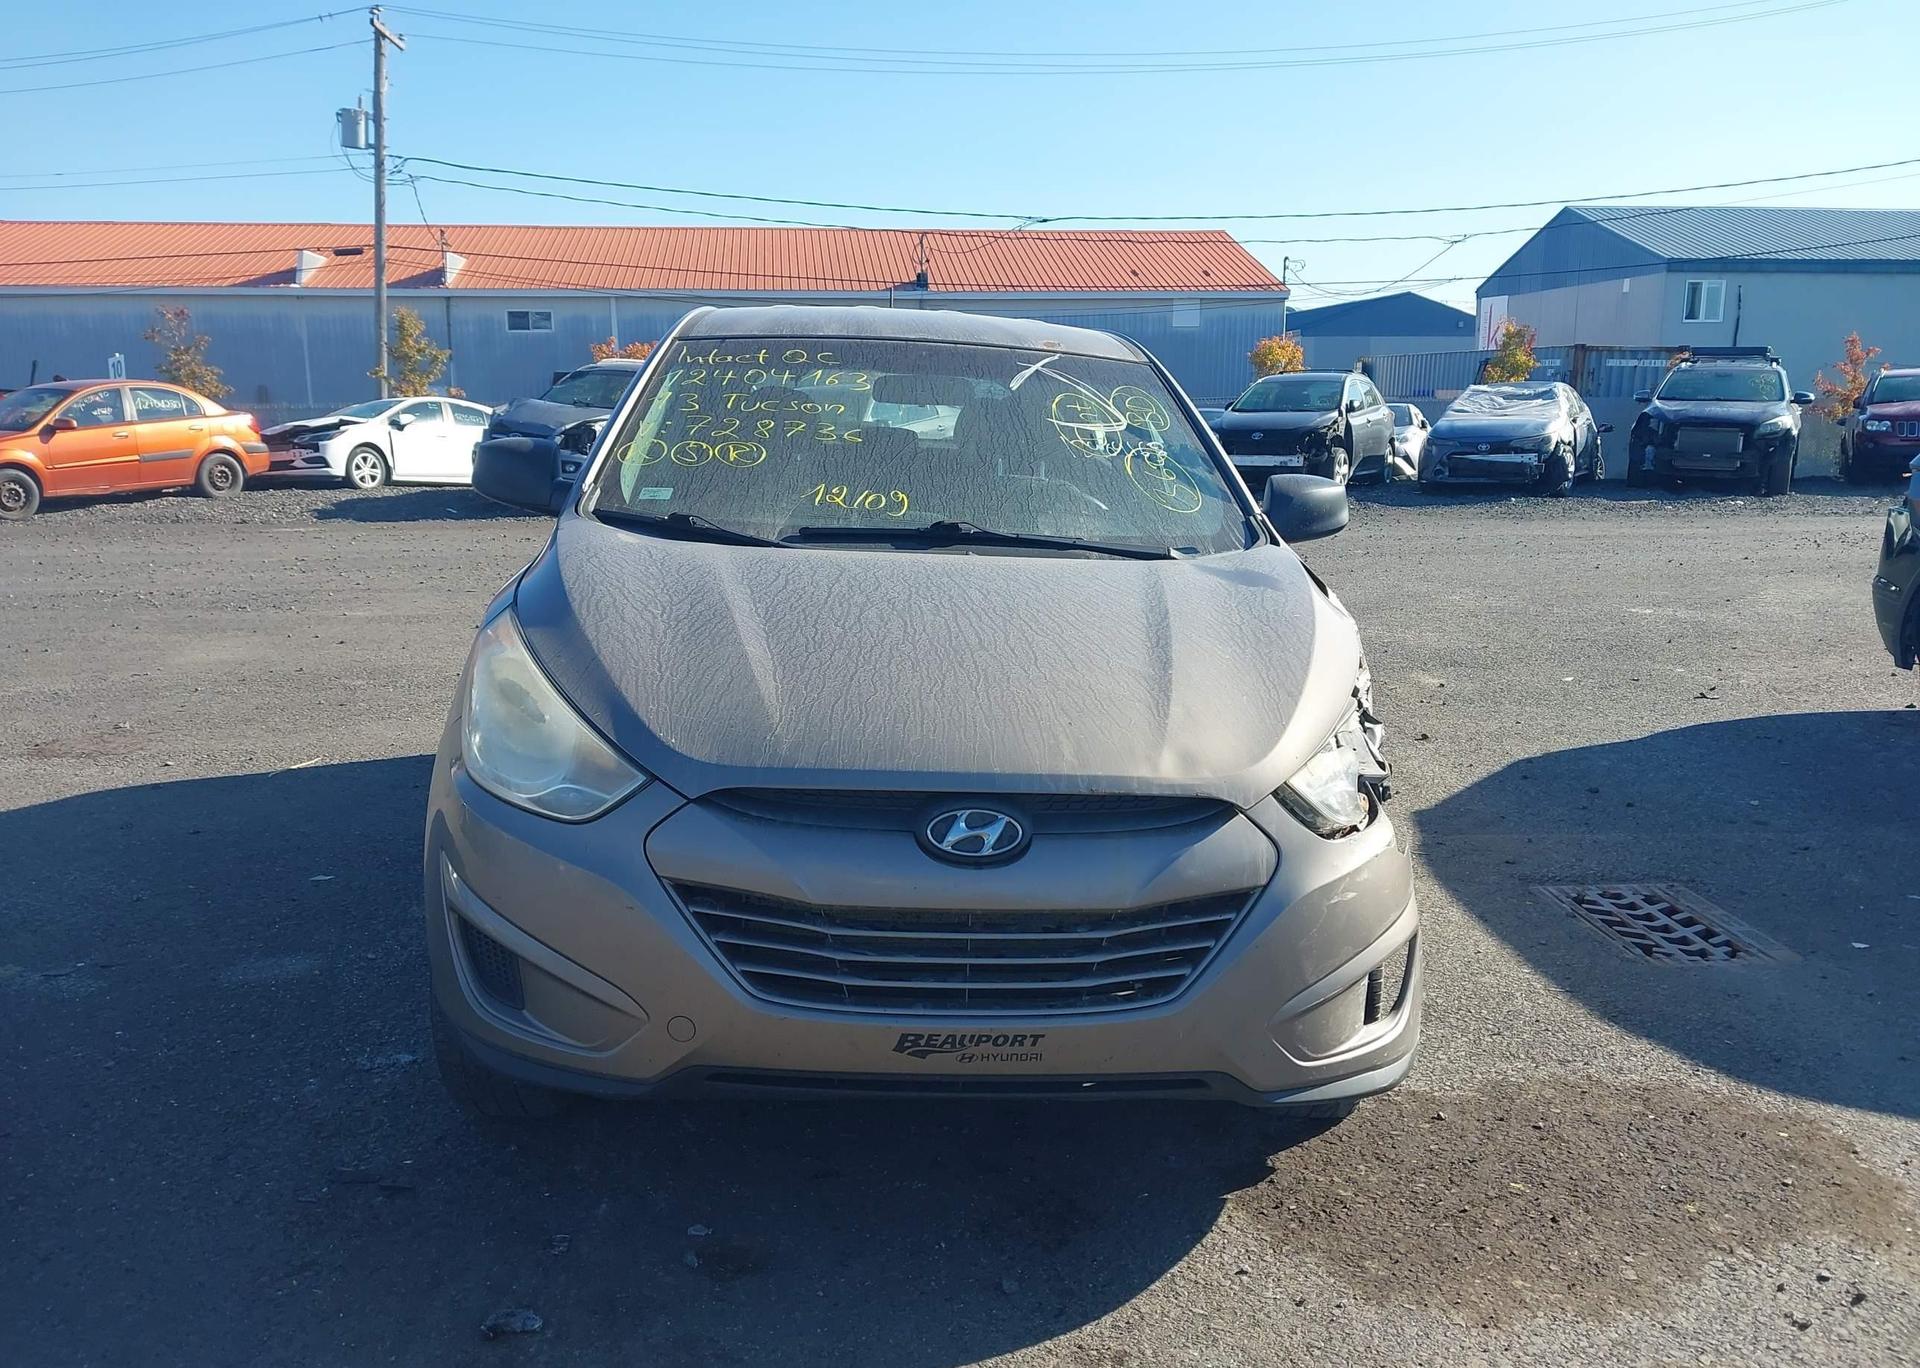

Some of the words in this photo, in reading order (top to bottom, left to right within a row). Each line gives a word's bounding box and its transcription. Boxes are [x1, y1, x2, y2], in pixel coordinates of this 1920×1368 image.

[678, 345, 769, 366] Intact
[111, 360, 123, 379] 10
[660, 368, 871, 391] 12404163
[722, 392, 846, 415] Tucson
[800, 483, 910, 517] 12/09
[893, 1033, 1045, 1053] BEAUPORT
[980, 1053, 1043, 1062] HYUNDAI
